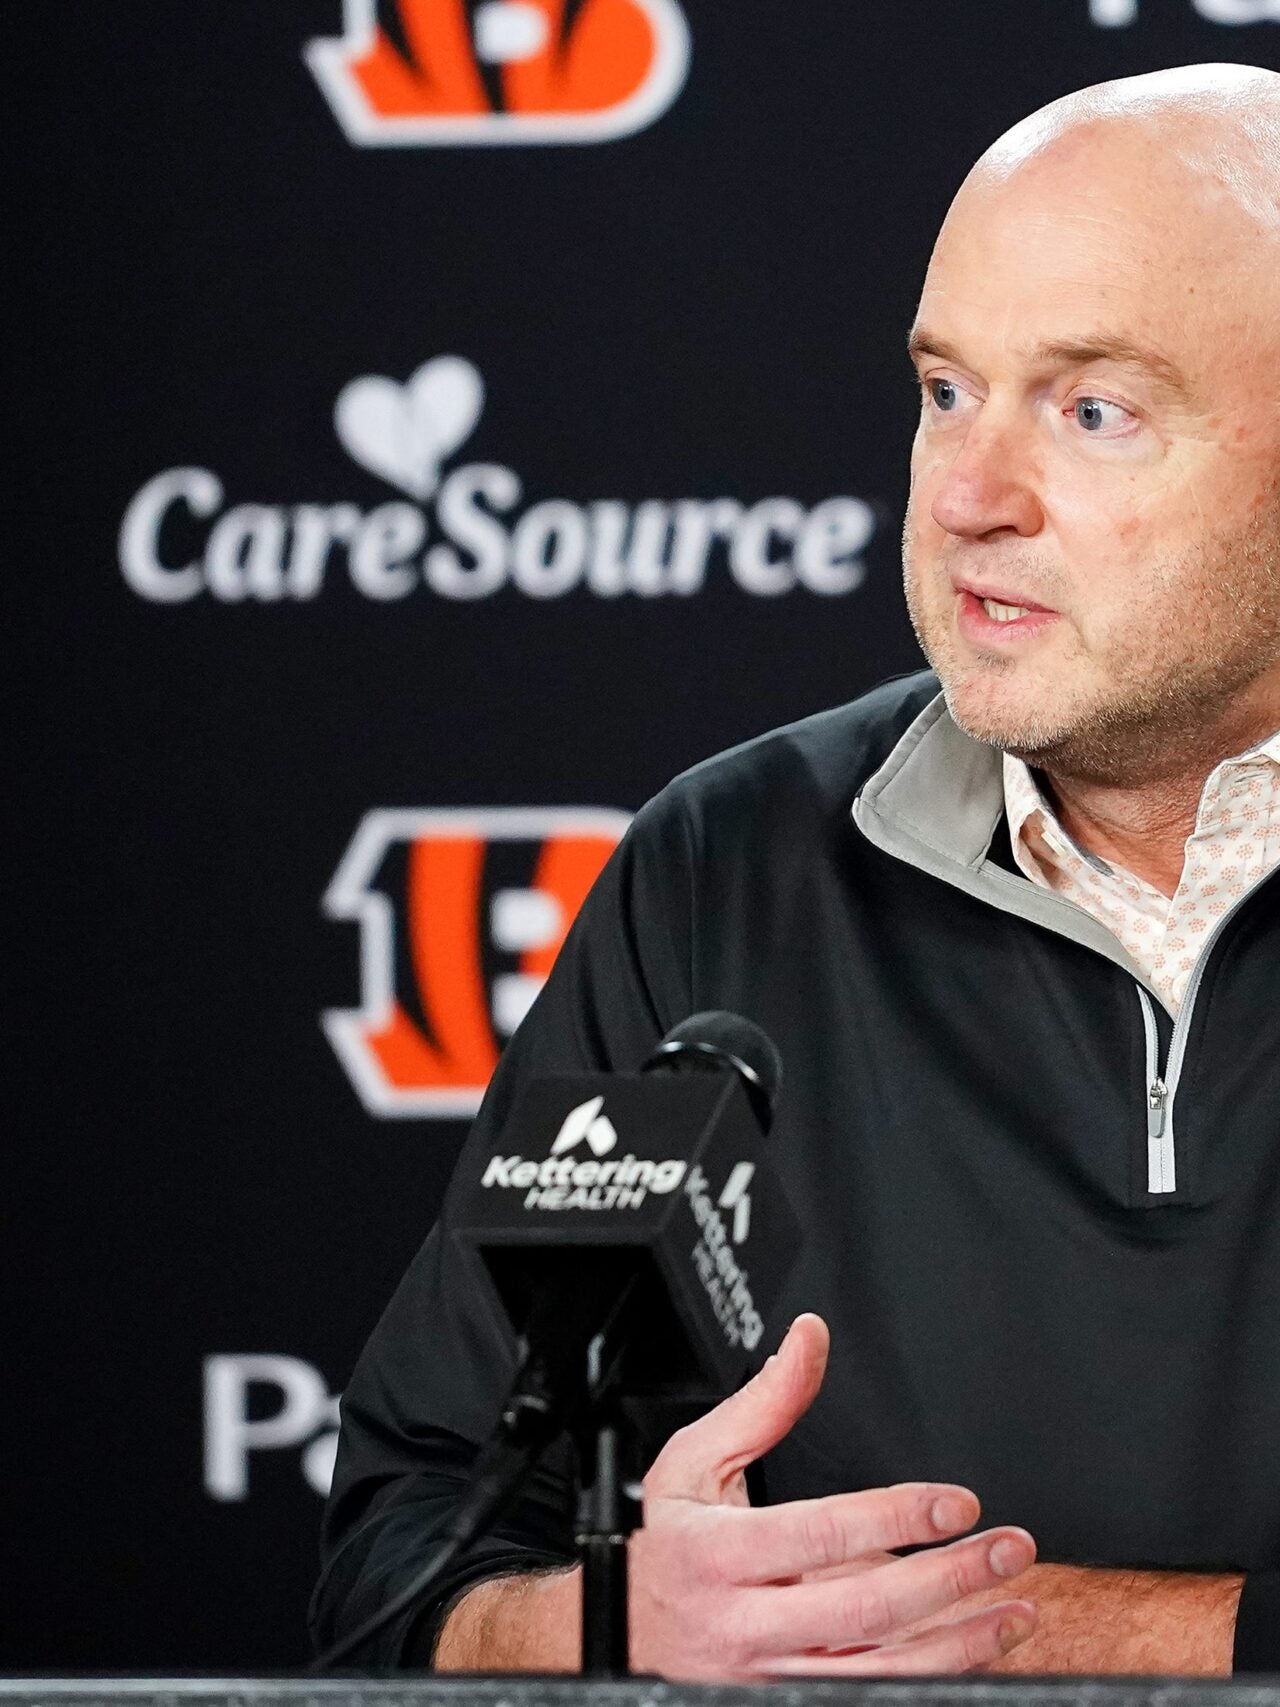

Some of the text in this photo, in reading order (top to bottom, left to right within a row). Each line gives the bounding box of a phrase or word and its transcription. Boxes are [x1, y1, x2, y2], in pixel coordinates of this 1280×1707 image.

[118, 463, 874, 602] CareSource
[481, 1154, 687, 1194] Kettering
[523, 1185, 647, 1211] HEALTH
